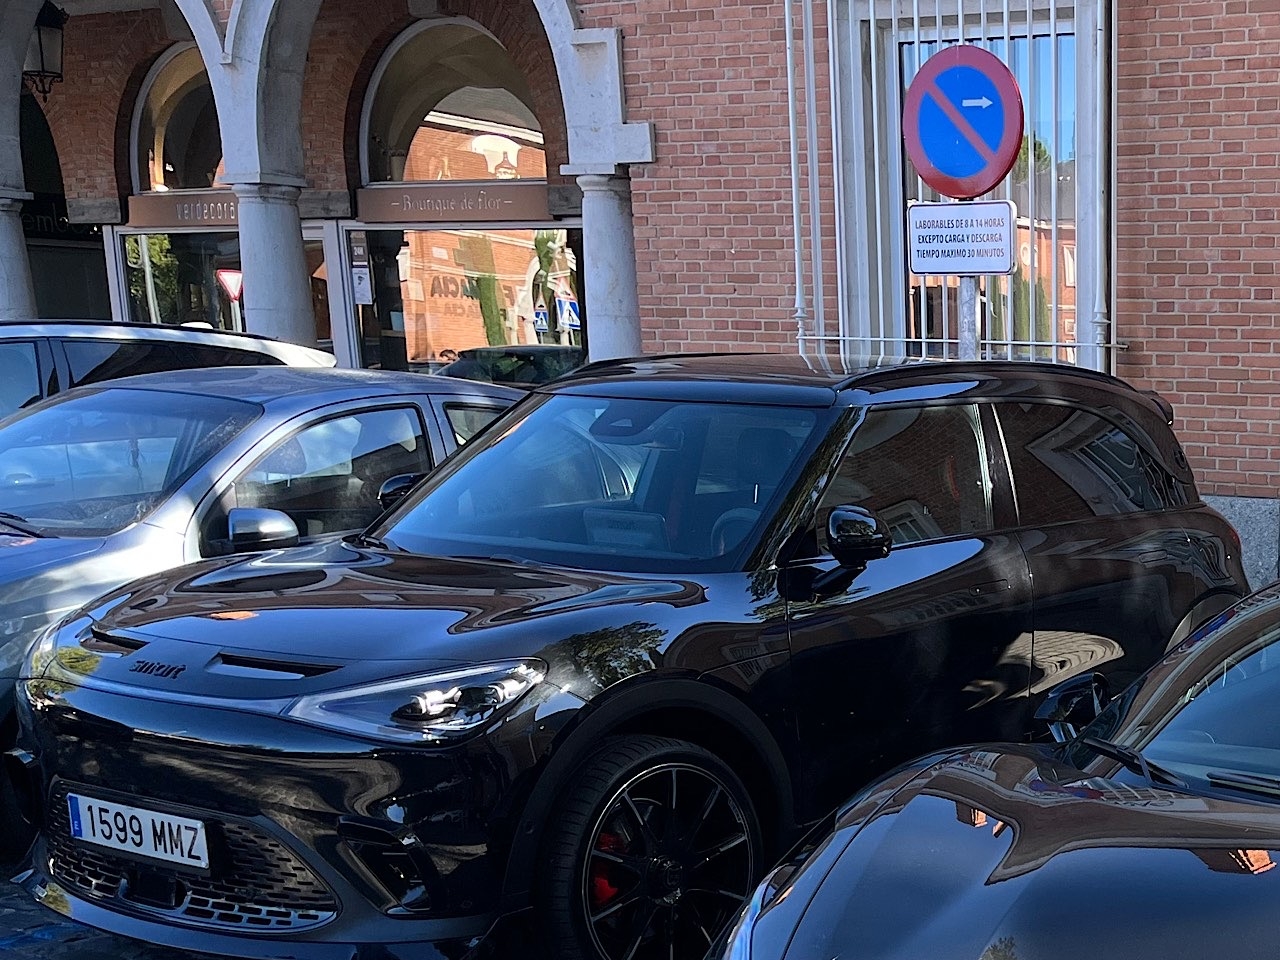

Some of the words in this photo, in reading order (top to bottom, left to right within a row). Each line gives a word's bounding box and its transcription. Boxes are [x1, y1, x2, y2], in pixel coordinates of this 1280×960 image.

[176, 202, 236, 220] verdecora
[402, 194, 455, 216] Boutique
[461, 193, 473, 210] de
[915, 219, 955, 230] LABORABLES
[955, 219, 964, 229] DE
[964, 219, 969, 228] 8
[970, 219, 975, 228] A
[976, 219, 984, 228] 14
[984, 217, 1005, 228] HORAS
[918, 234, 944, 244] EXCEPTO
[944, 234, 965, 243] CARGA
[966, 234, 970, 243] Y
[971, 233, 1003, 243] DESCARGA
[917, 249, 940, 258] TIEMPO
[940, 249, 967, 259] MAXIMO
[967, 249, 976, 258] 30
[976, 248, 1005, 258] MINUTOS
[87, 805, 144, 848] 1599
[151, 818, 202, 860] MMZ
